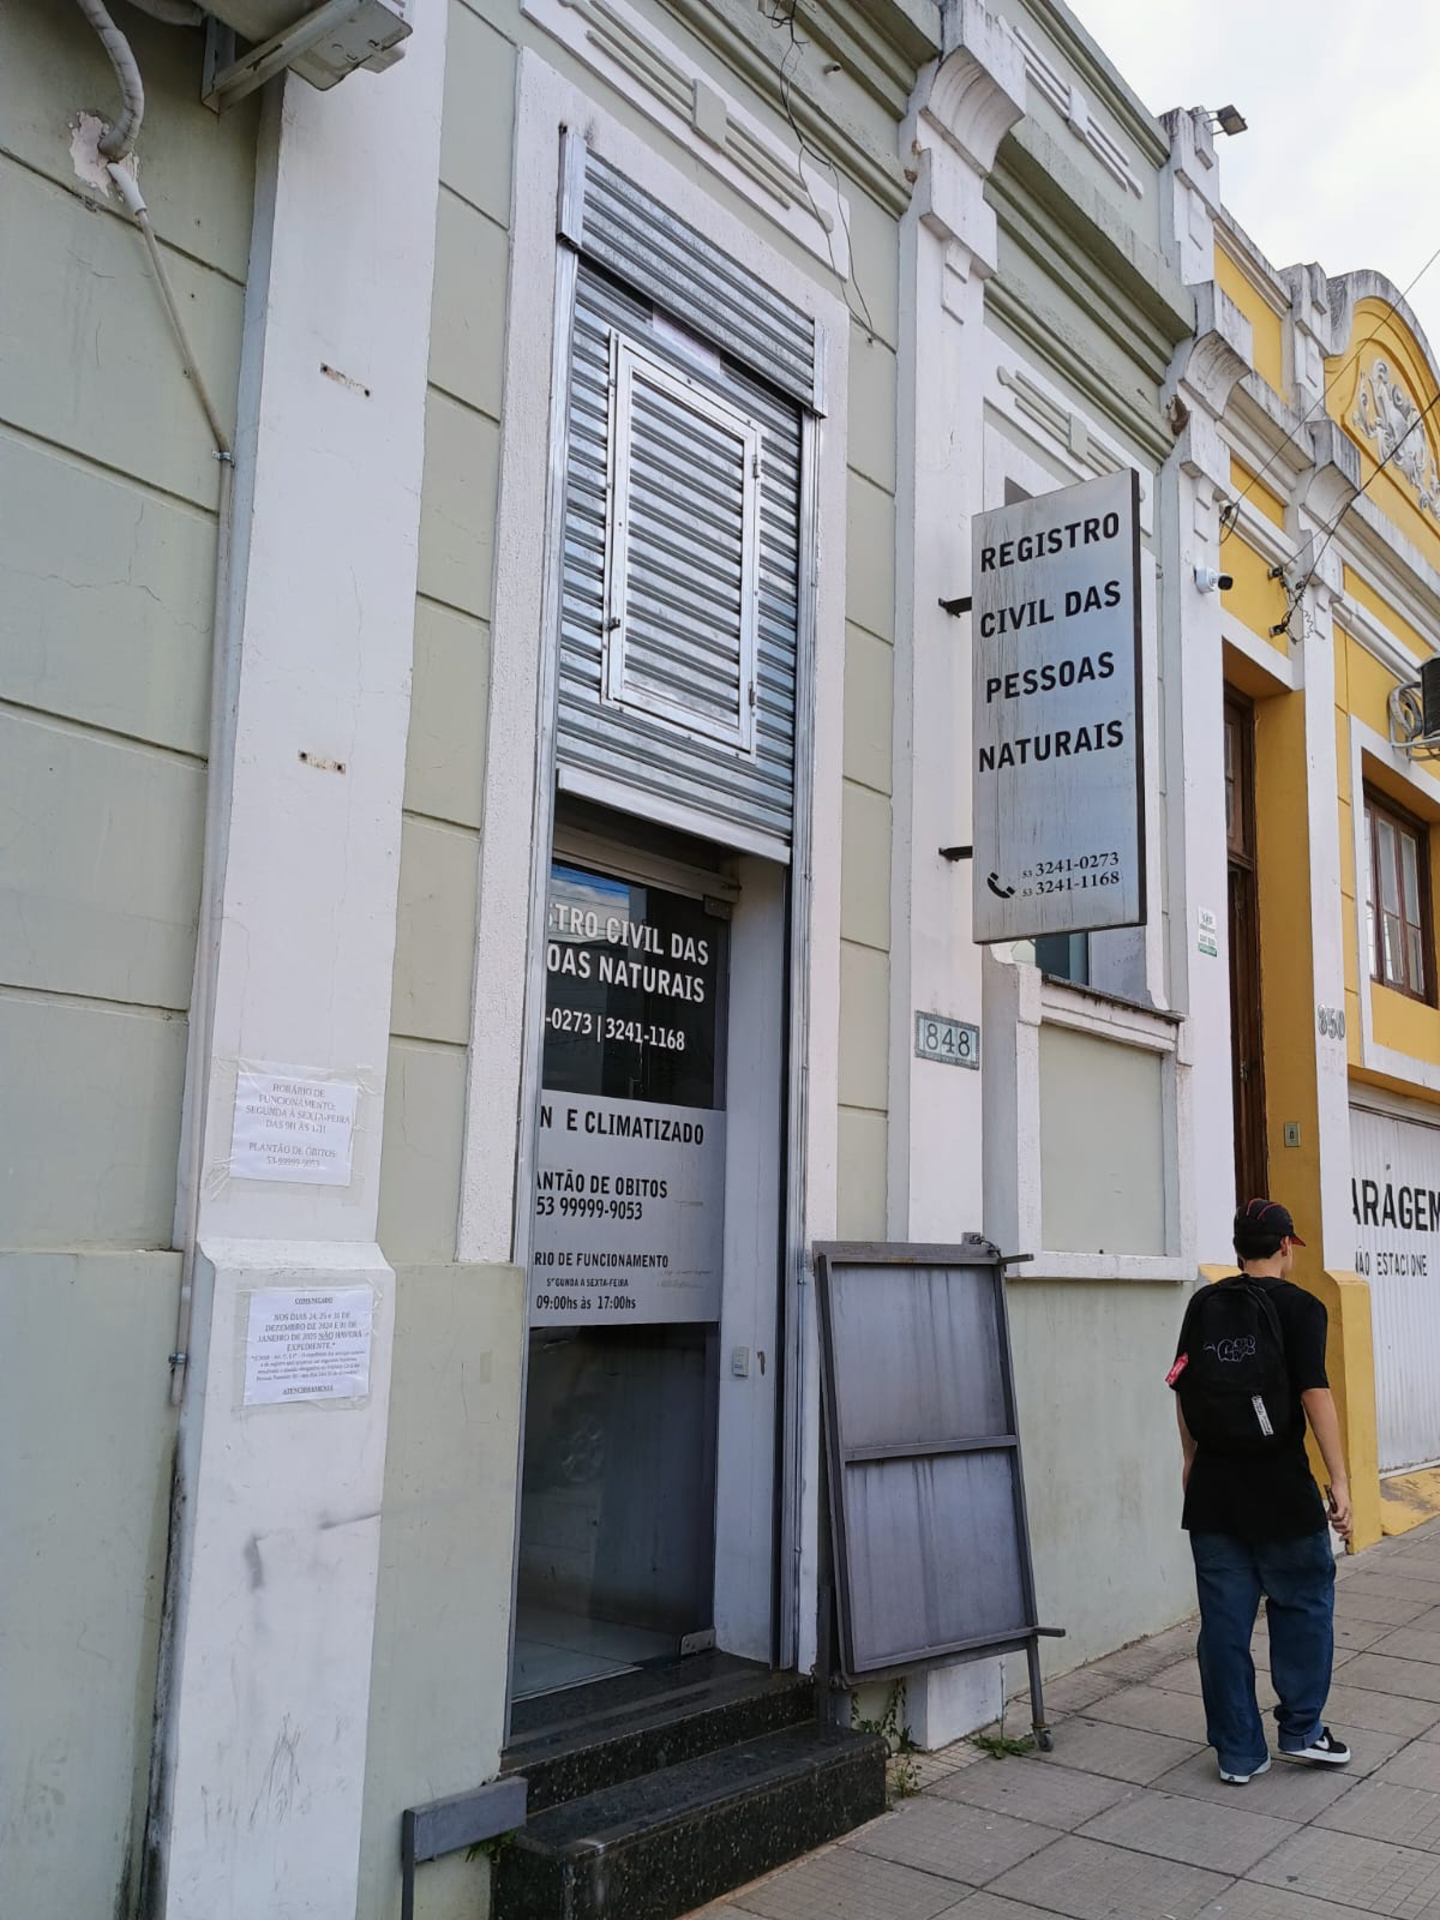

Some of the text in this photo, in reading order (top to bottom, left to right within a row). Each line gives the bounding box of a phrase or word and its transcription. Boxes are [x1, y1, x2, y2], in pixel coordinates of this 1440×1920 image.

[981, 511, 1120, 573] REGISTRO
[980, 580, 1122, 638] CIVIL DAS
[986, 651, 1115, 703] PESSOAS
[979, 720, 1124, 773] NATURAIS
[1022, 851, 1119, 879] 53 3241-0273
[1022, 871, 1120, 897] 53 3241-1168
[606, 917, 664, 955] CIVIL
[671, 932, 709, 966] DAS
[598, 955, 705, 1003] NATURAIS
[605, 1017, 685, 1051] 3241-1168
[1317, 1003, 1345, 1041] 850
[926, 1023, 970, 1057] 848
[272, 1083, 325, 1098] HORÁRIO DE
[245, 1105, 287, 1118] SEGUNDA
[297, 1110, 350, 1124] SEXTA-FEIRA
[266, 1120, 284, 1129] DAS
[566, 1109, 578, 1131] E
[585, 1111, 704, 1145] CLIMATIZADO
[249, 1142, 290, 1154] PLANTÃO
[292, 1145, 303, 1155] DE
[590, 1175, 610, 1195] DE
[615, 1177, 667, 1199] OBITOS
[536, 1196, 643, 1221] 53 99999-9053
[558, 1252, 573, 1266] DE
[576, 1253, 669, 1268] FUNCIONAMENTO
[1377, 1252, 1428, 1277] ESTACIONE
[579, 1278, 585, 1287] A
[586, 1278, 629, 1287] SEXTA-FEIRA
[536, 1295, 636, 1310] 09:00hs às 17:00hs
[265, 1323, 305, 1332] DEZEMBRO
[274, 1313, 289, 1321] NOS
[258, 1334, 289, 1342] JANEIRO
[317, 1331, 333, 1340] NÃO
